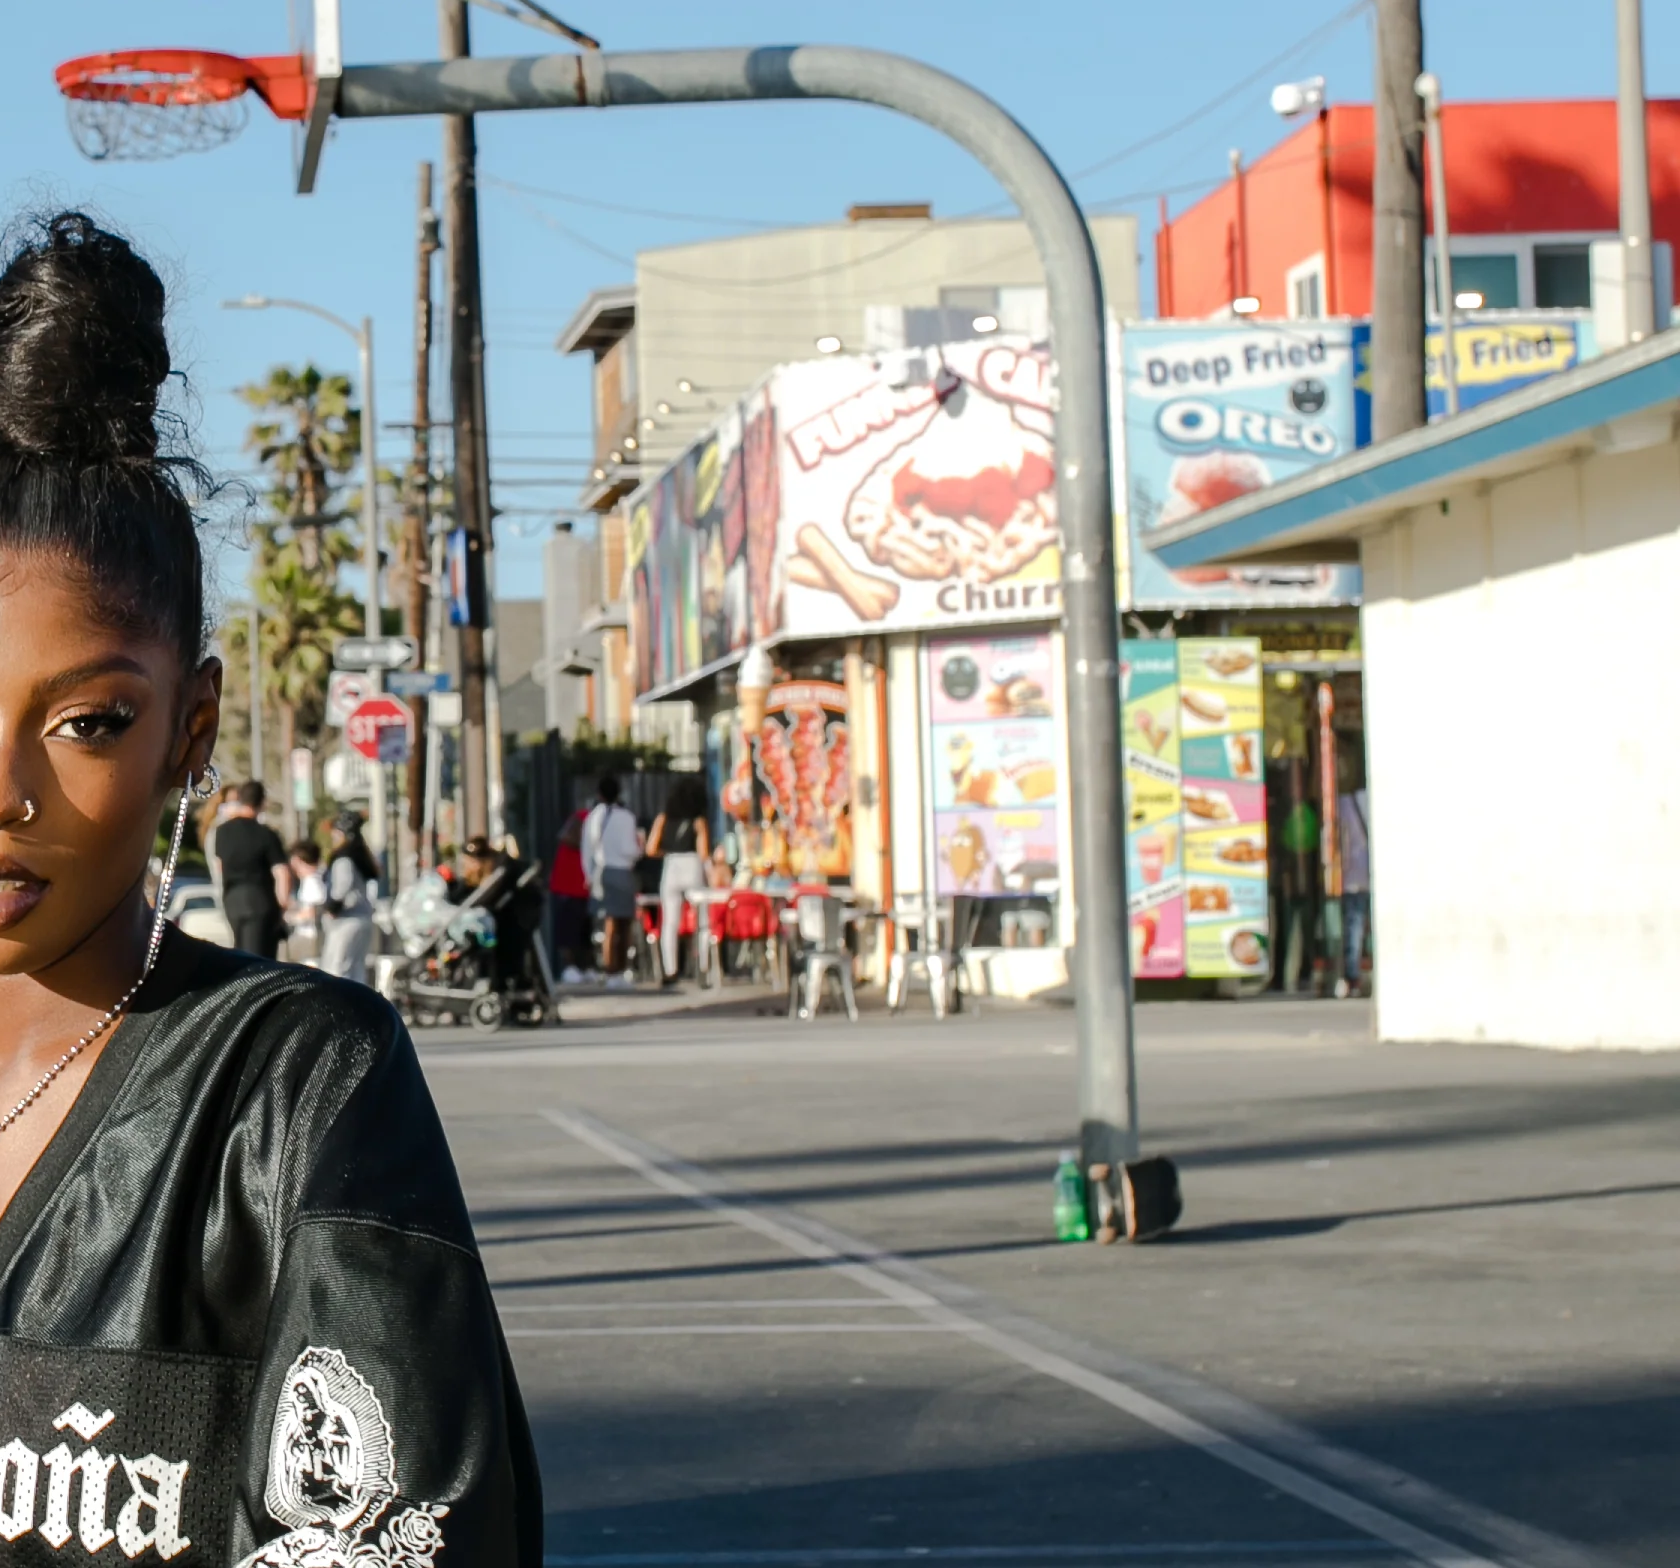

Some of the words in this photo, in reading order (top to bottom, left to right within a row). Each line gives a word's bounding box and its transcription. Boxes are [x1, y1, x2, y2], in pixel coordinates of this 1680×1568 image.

[1147, 355, 1231, 386] Deep
[1243, 334, 1326, 372] Fried
[1472, 330, 1554, 369] Fried
[785, 376, 942, 473] FUNN
[1156, 397, 1338, 458] OREO
[936, 582, 1061, 613] Churr
